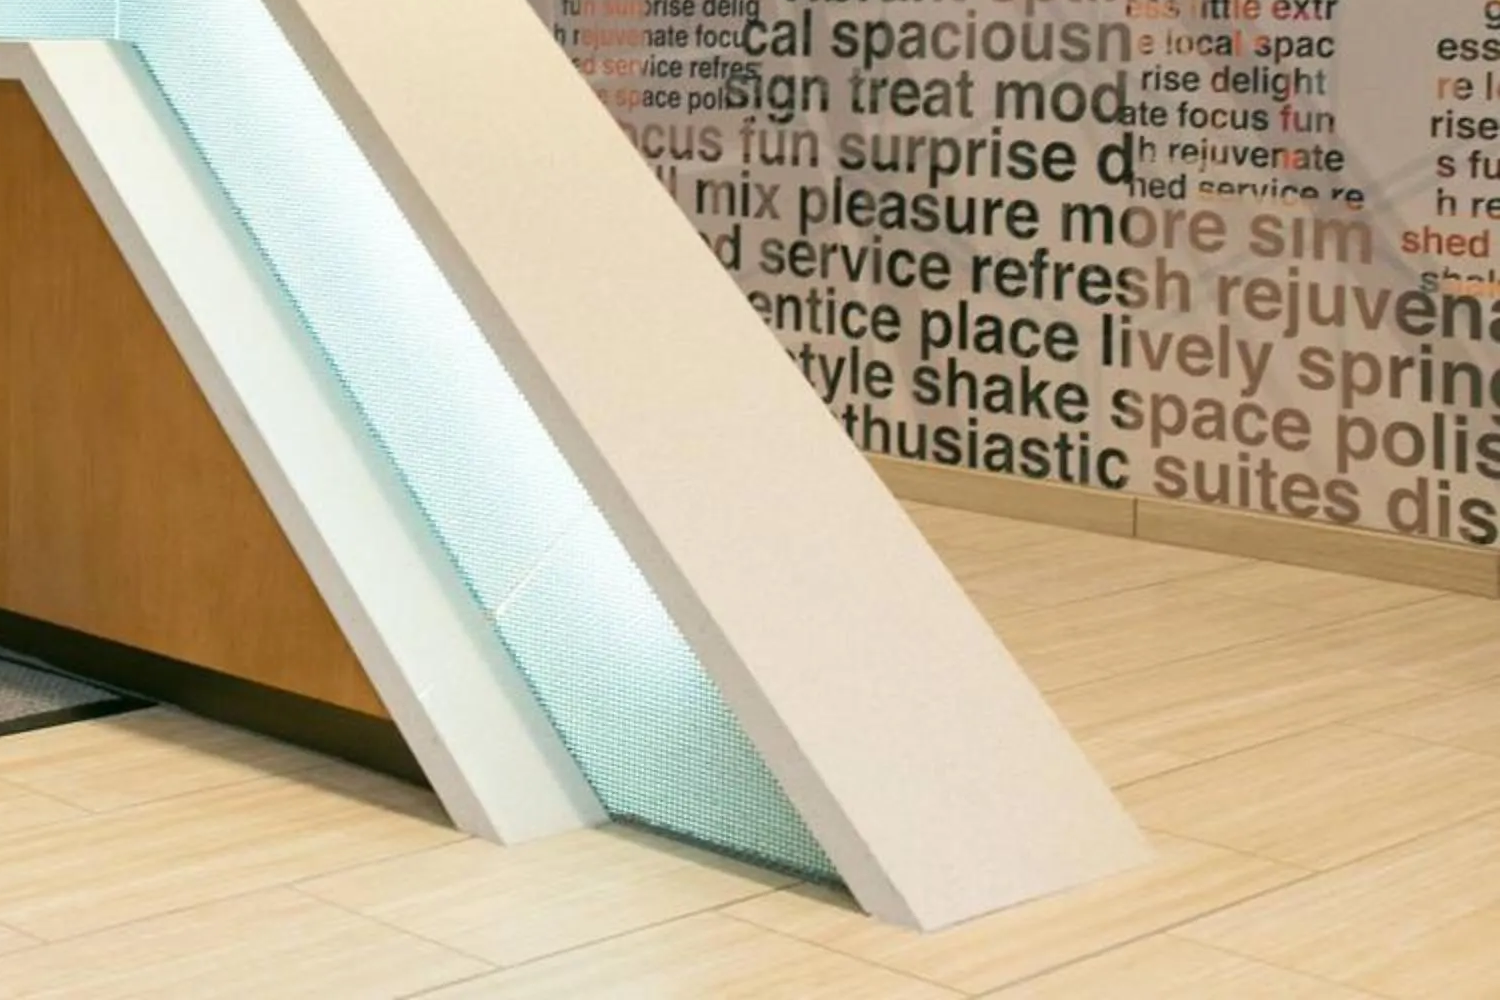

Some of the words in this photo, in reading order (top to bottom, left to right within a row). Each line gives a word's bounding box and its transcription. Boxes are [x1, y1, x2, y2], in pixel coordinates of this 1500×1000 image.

[743, 10, 812, 57] cal
[832, 11, 1132, 70] spaciousn
[1254, 33, 1335, 64] spac
[725, 70, 829, 124] sign
[849, 69, 974, 119] treat
[995, 70, 1128, 125] mod
[1141, 65, 1200, 92] rise
[1210, 65, 1327, 102] delight
[1437, 76, 1474, 101] re
[1121, 101, 1168, 127] ate
[1178, 101, 1269, 131] focus
[1280, 104, 1335, 133] fun
[1430, 109, 1500, 140] rise
[740, 116, 818, 168] fun
[838, 127, 1076, 188] surprise
[1098, 132, 1134, 184] d
[1168, 138, 1345, 173] rejuvenate
[1436, 153, 1456, 178] s
[696, 170, 781, 221] mix
[800, 175, 1039, 237] pleasure
[1062, 201, 1227, 253] more
[1249, 211, 1373, 264] sim
[1331, 188, 1365, 211] re
[1402, 224, 1490, 258] shed
[759, 237, 950, 290] service
[972, 248, 1191, 313] refresh
[748, 287, 901, 343] entice
[921, 300, 1078, 361] place
[1102, 313, 1274, 396] lively
[786, 343, 894, 404] tyle
[913, 357, 1089, 425] shake
[1110, 386, 1311, 452] space
[1153, 452, 1360, 525] suites
[1387, 477, 1498, 545] dis
